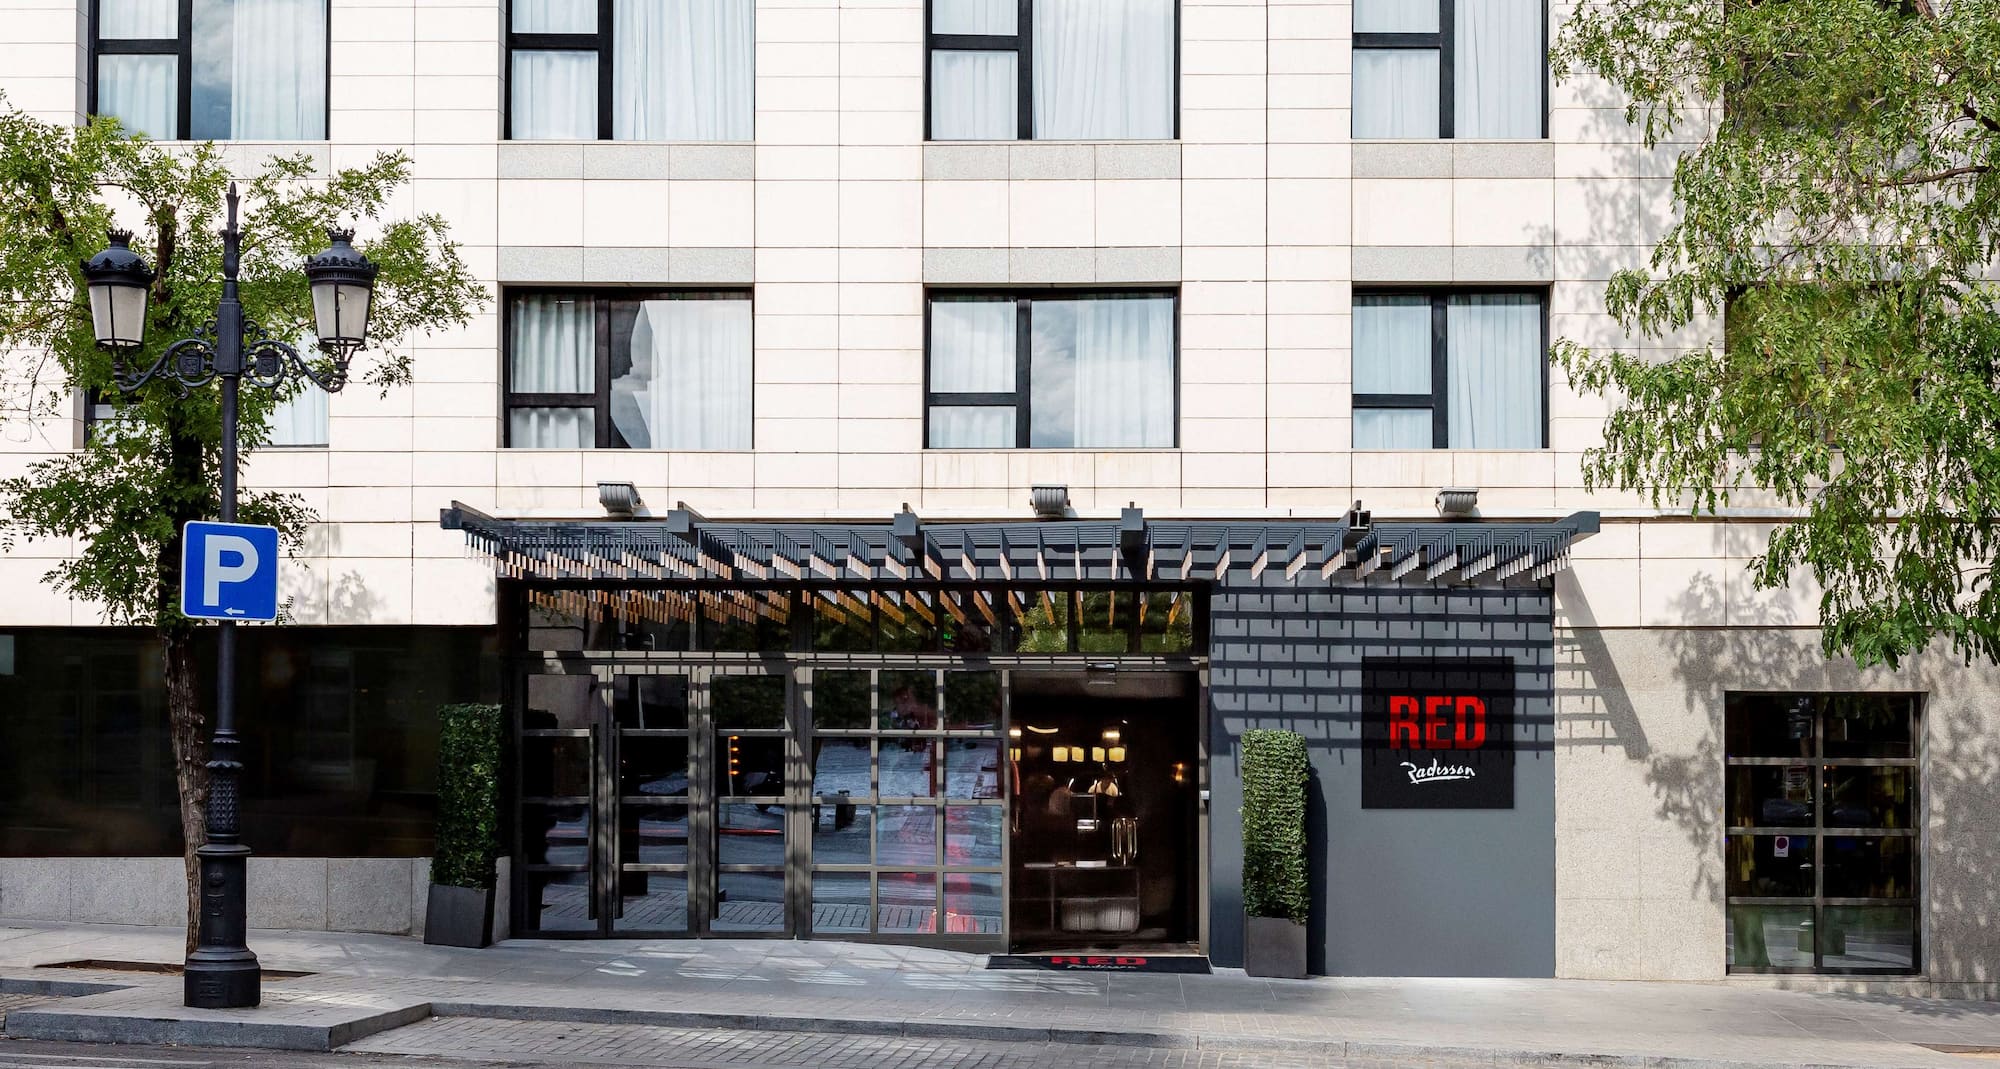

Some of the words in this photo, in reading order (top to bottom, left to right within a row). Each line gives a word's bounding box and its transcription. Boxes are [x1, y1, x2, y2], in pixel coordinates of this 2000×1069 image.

[203, 534, 259, 606] P
[1389, 695, 1486, 750] RED
[1399, 758, 1476, 784] Radisson
[1051, 956, 1147, 966] RED
